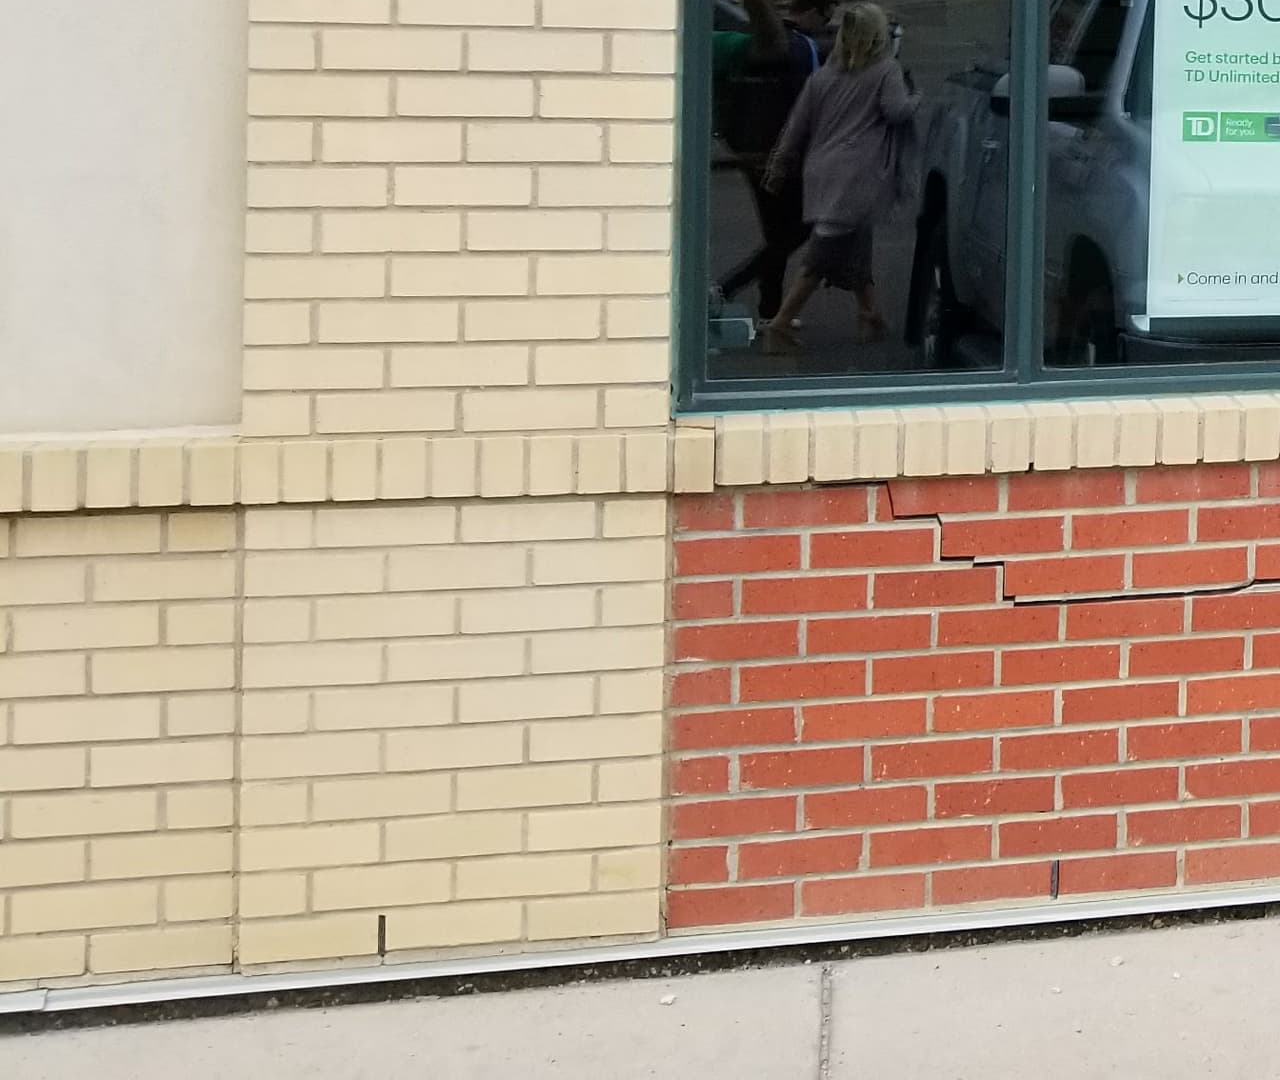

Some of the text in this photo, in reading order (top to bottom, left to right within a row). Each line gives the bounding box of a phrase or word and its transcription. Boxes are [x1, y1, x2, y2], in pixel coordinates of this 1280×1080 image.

[1184, 50, 1212, 65] Get
[1215, 51, 1269, 66] started
[1184, 69, 1206, 83] TD
[1208, 70, 1280, 85] Unlimited
[1185, 116, 1216, 137] TD
[1225, 118, 1254, 130] Ready
[1225, 126, 1256, 138] for you
[1186, 271, 1232, 286] Come
[1234, 270, 1247, 285] in
[1249, 270, 1279, 285] and
